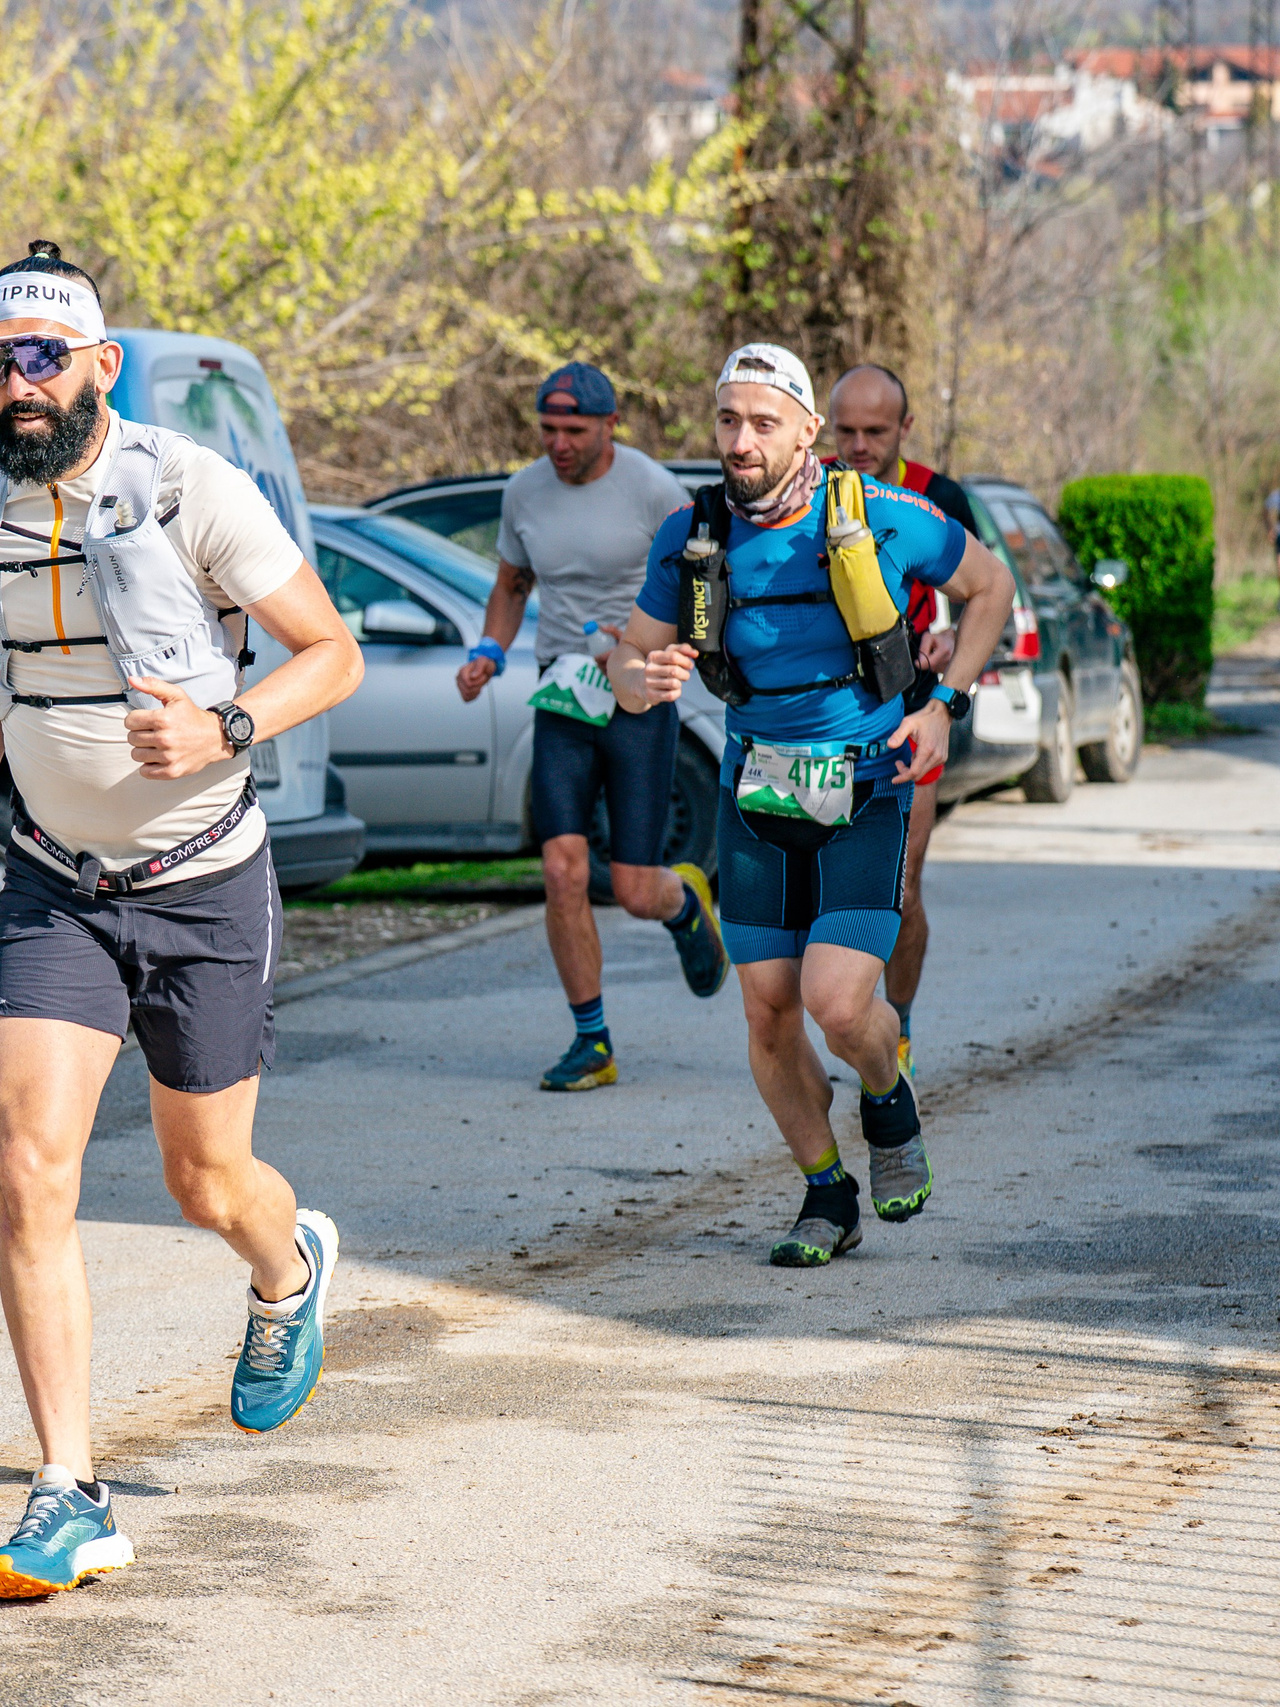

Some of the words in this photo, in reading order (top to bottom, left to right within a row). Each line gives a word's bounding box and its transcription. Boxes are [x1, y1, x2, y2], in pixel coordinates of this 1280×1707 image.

[108, 555, 129, 593] KIPRUN
[747, 767, 763, 778] 44K
[787, 758, 847, 789] 4175
[40, 835, 78, 871] COMPRE
[160, 803, 243, 868] COMPRESSPORT
